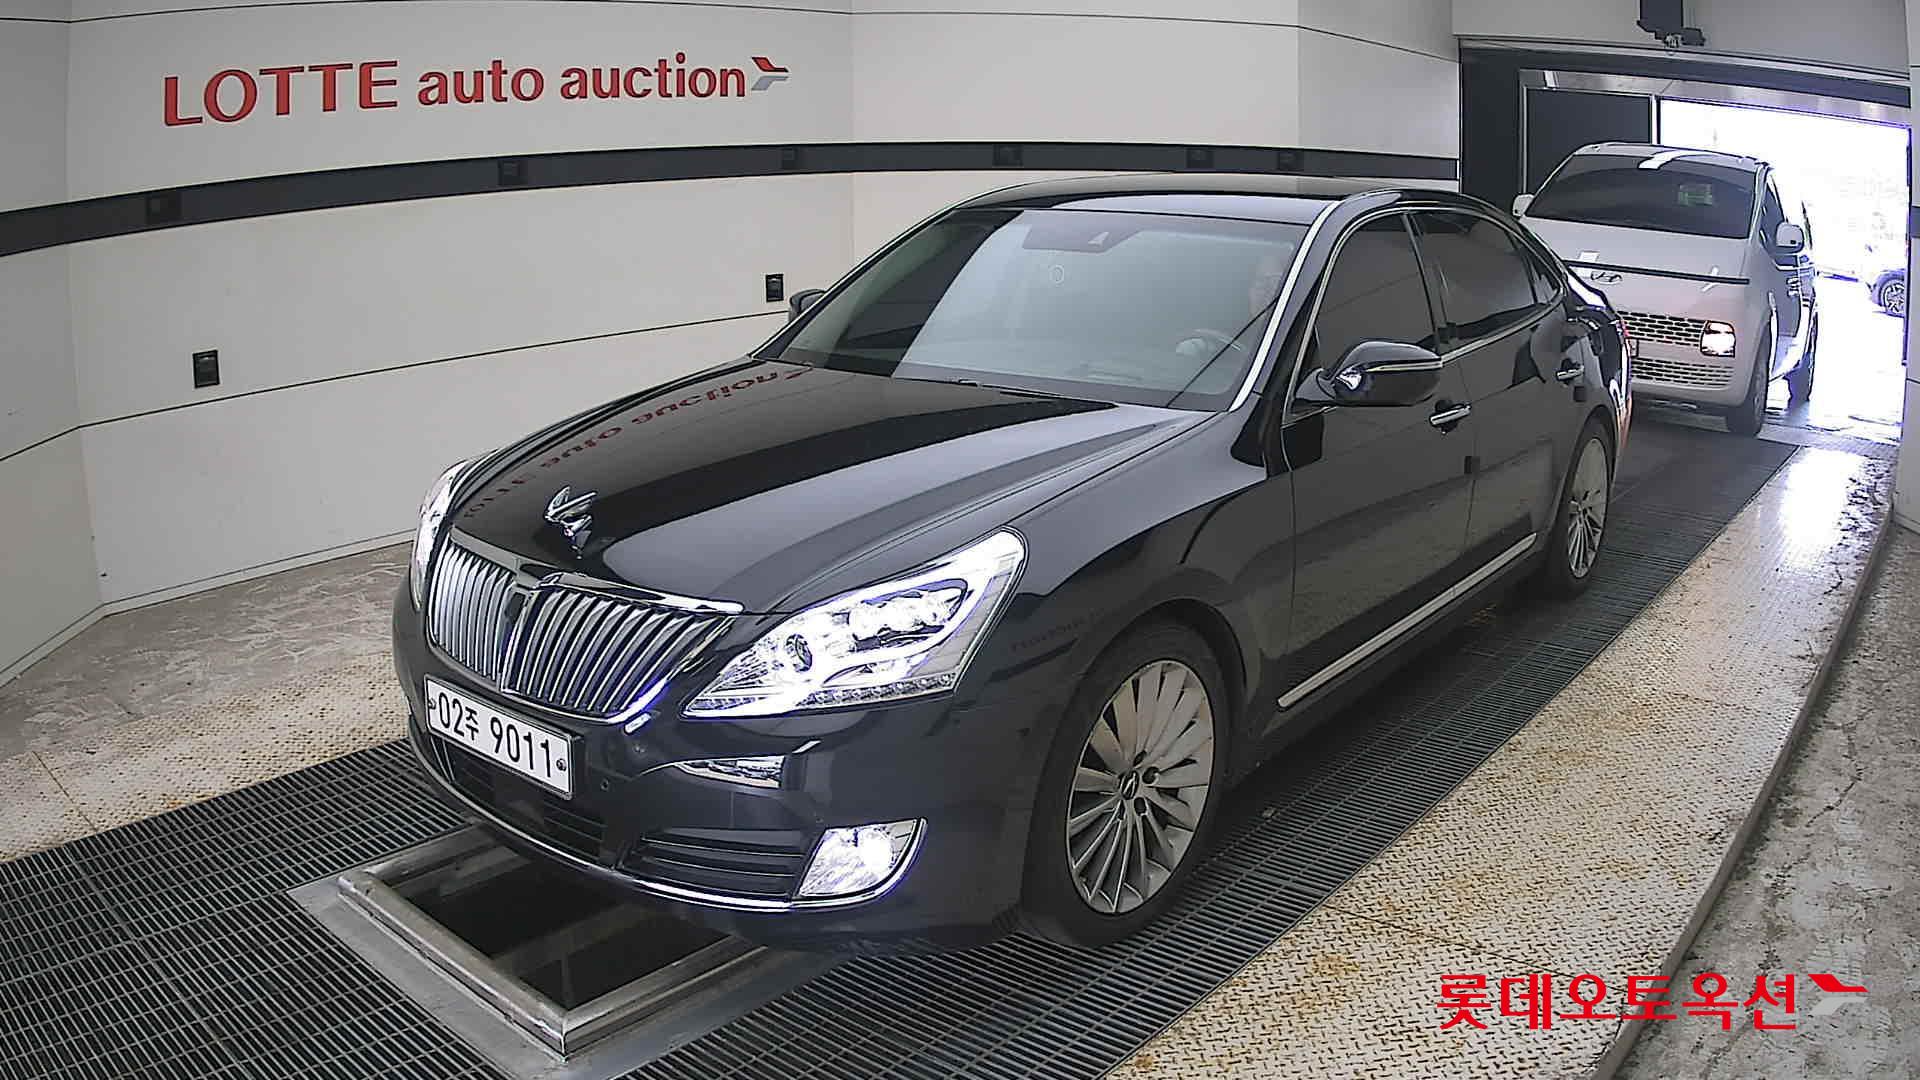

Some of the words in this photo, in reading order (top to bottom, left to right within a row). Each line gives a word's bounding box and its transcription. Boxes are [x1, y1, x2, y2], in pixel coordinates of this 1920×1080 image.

[164, 61, 398, 126] LOTTE
[417, 61, 544, 105] auto
[561, 54, 746, 99] auction
[438, 692, 479, 741] 02주
[490, 717, 551, 778] 9011
